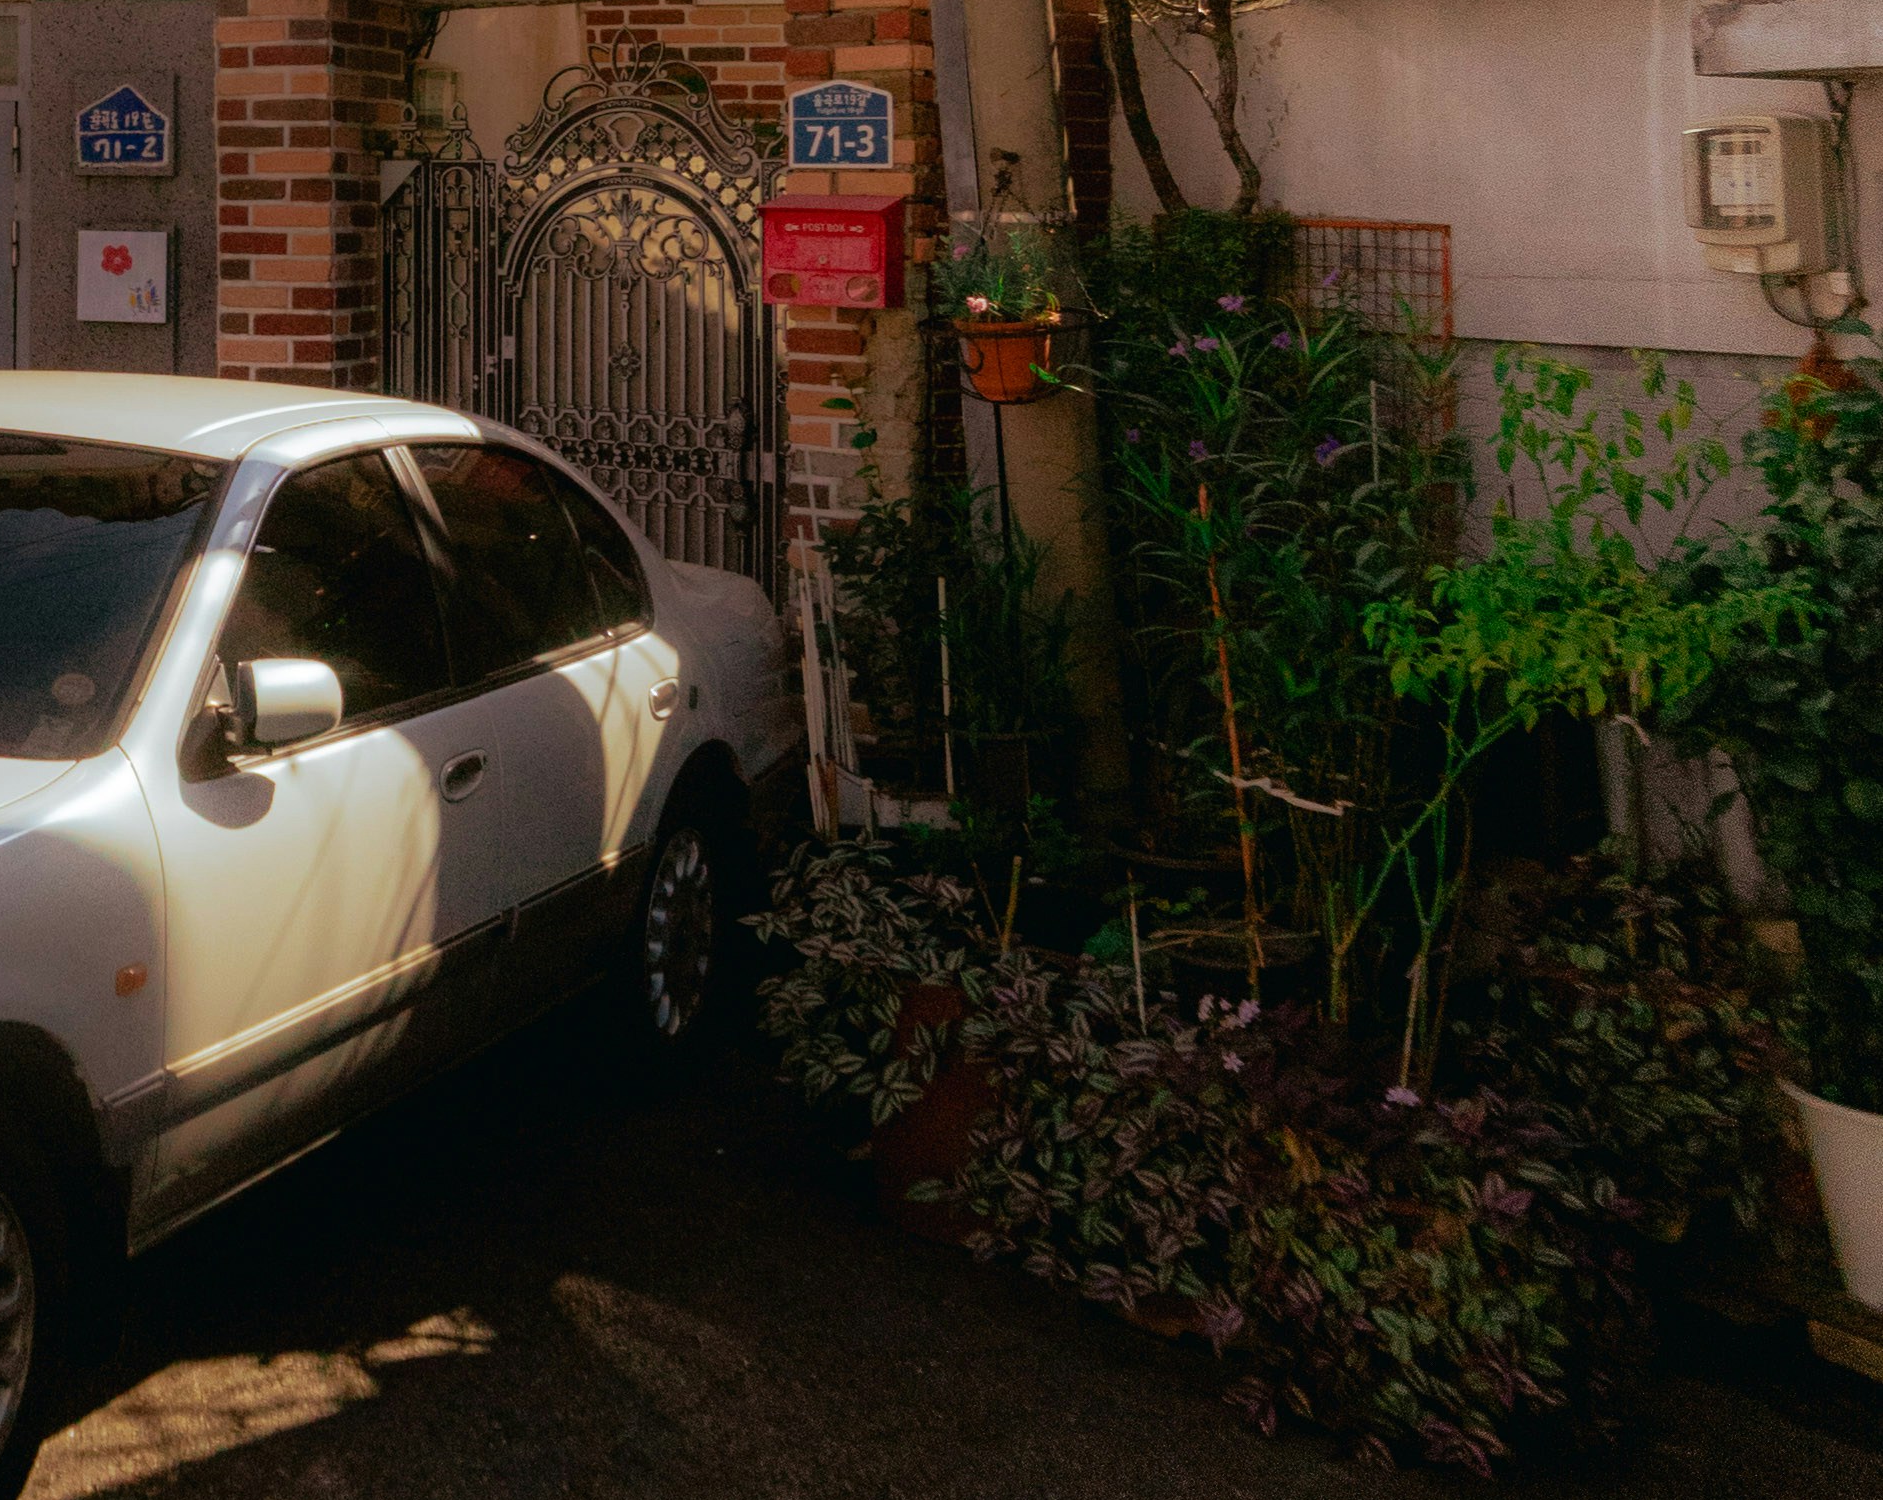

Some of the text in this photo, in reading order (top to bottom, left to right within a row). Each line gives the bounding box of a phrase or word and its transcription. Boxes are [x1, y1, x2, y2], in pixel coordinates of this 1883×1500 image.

[94, 136, 157, 159] 71-2
[806, 124, 875, 158] 71-3
[802, 223, 825, 232] POST
